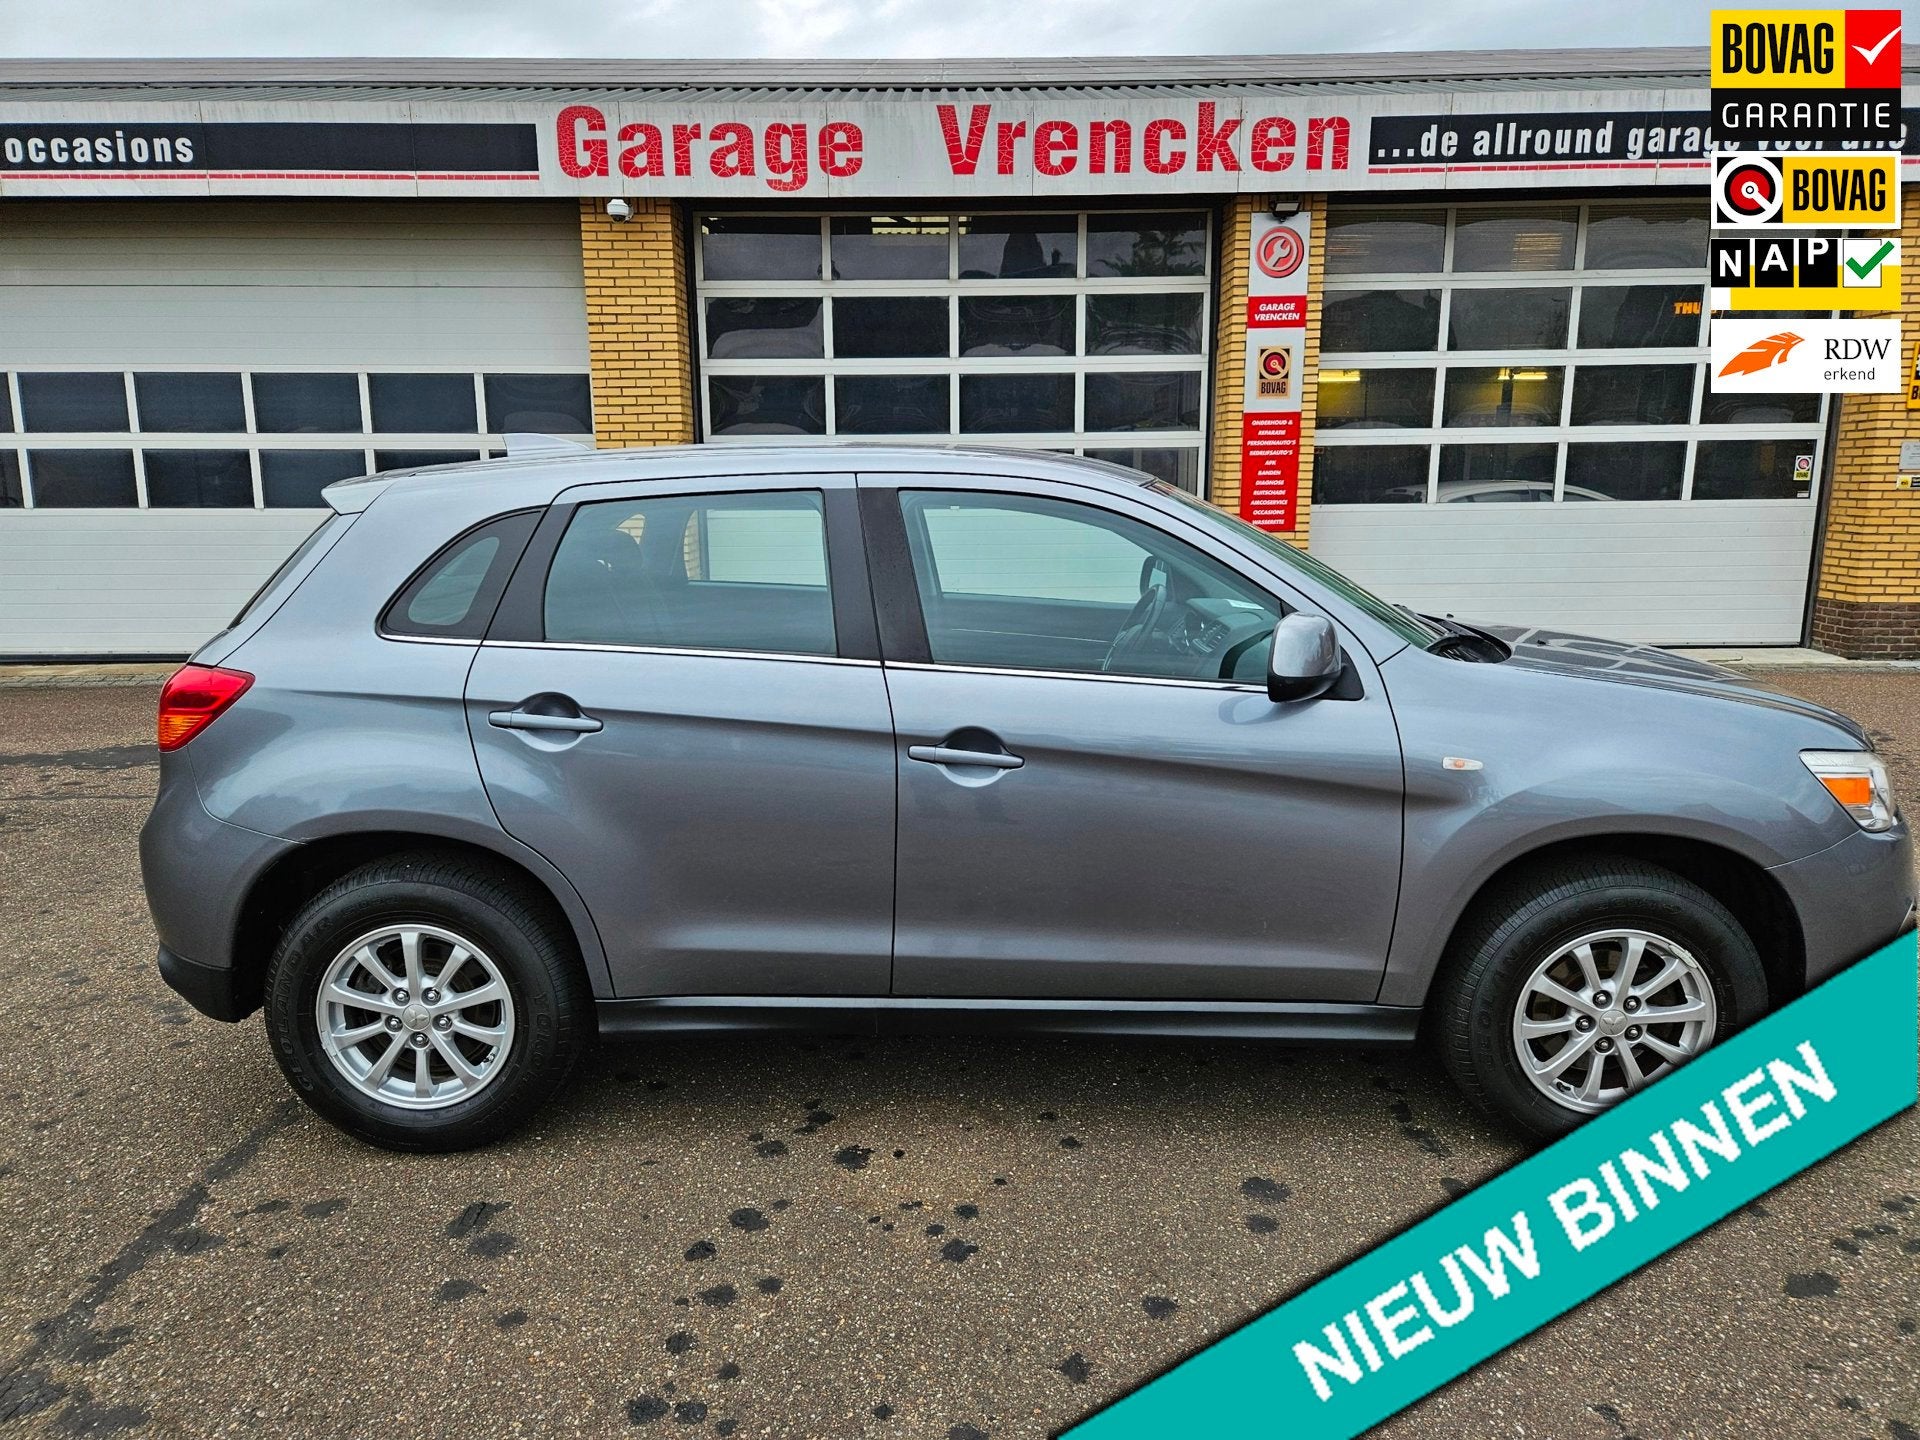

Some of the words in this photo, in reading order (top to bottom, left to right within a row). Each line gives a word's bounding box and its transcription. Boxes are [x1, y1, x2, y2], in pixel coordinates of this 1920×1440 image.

[1472, 122, 1614, 156] allround
[4, 130, 194, 163] occasions
[556, 104, 863, 192] Garage
[936, 101, 1351, 176] Vrencken
[1259, 303, 1295, 312] GARAGE
[1254, 312, 1300, 321] VRENCKEN
[1260, 381, 1286, 394] BOVAG
[1246, 439, 1297, 447] PERSONENAUTO'S
